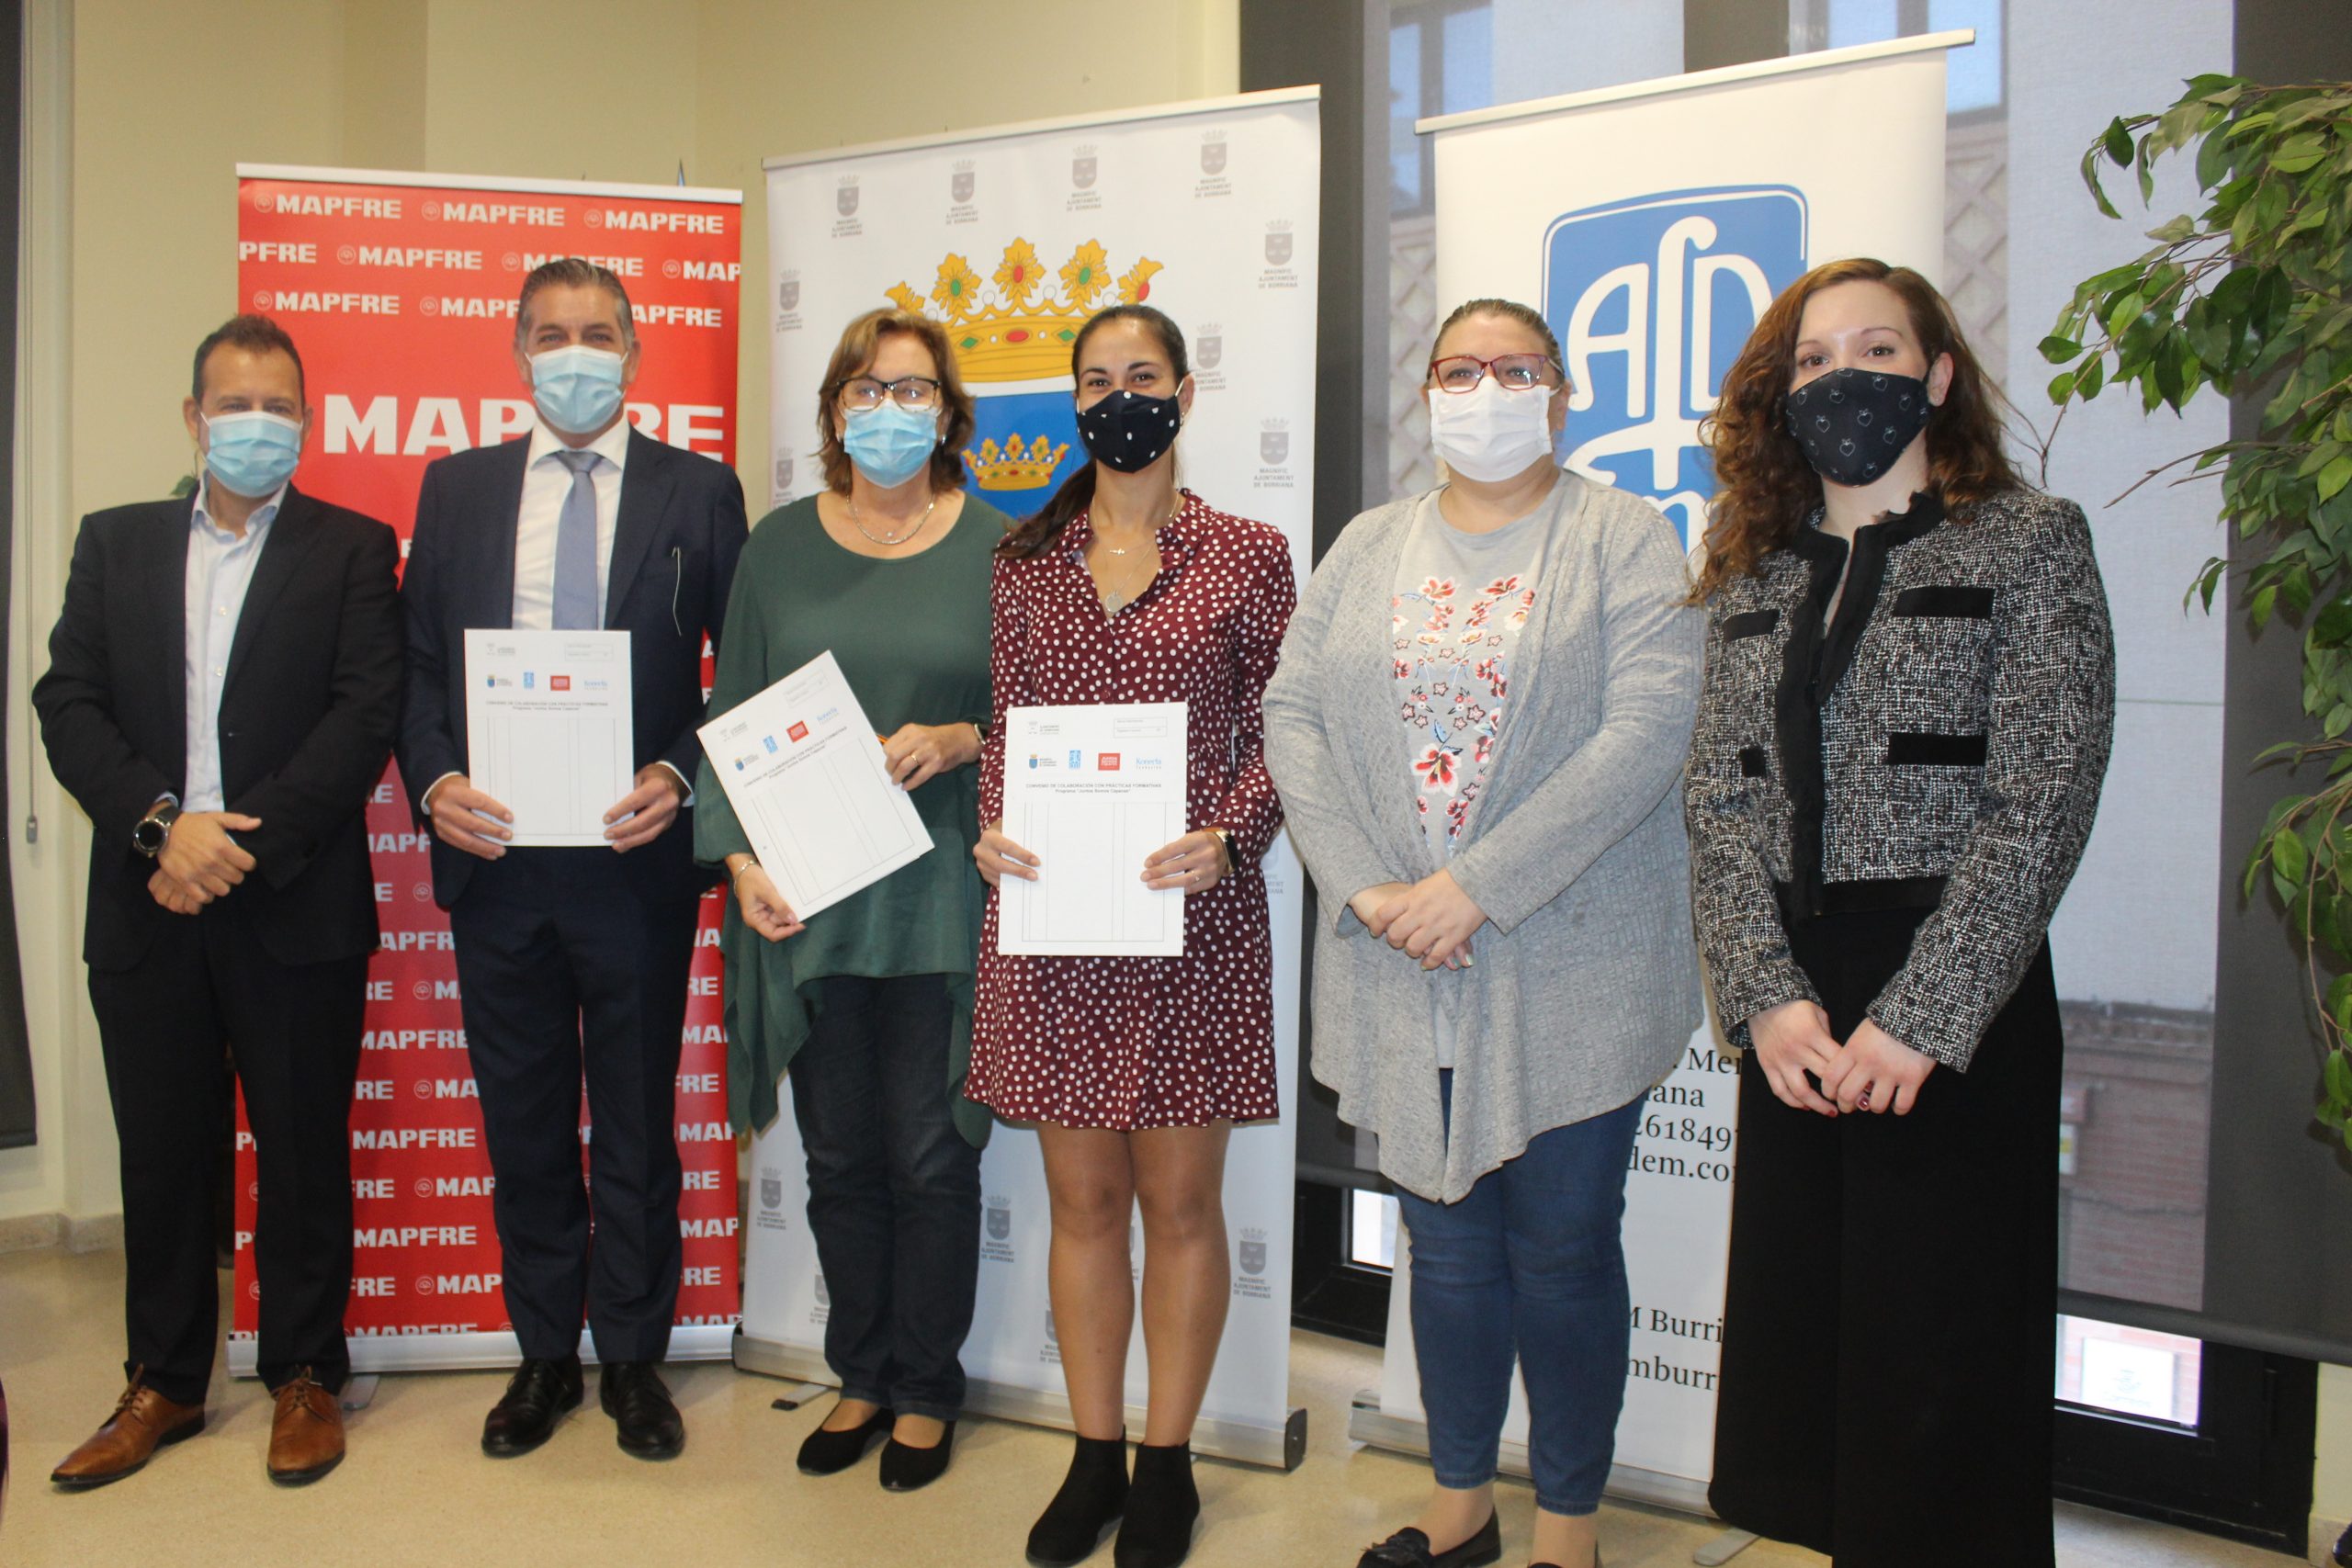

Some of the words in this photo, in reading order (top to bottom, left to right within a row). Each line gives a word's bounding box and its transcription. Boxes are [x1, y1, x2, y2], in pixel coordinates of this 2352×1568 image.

[277, 194, 401, 220] MAPFRE
[443, 202, 565, 227] MAPFRE
[605, 209, 724, 234] MAPFRE
[358, 245, 482, 270] MAPFRE
[276, 291, 400, 315] MAPFRE
[352, 1127, 477, 1150] MAPFRE
[1634, 1113, 1732, 1153] 61849
[353, 1225, 478, 1249] MAPFRE
[1650, 1308, 1723, 1343] Burri
